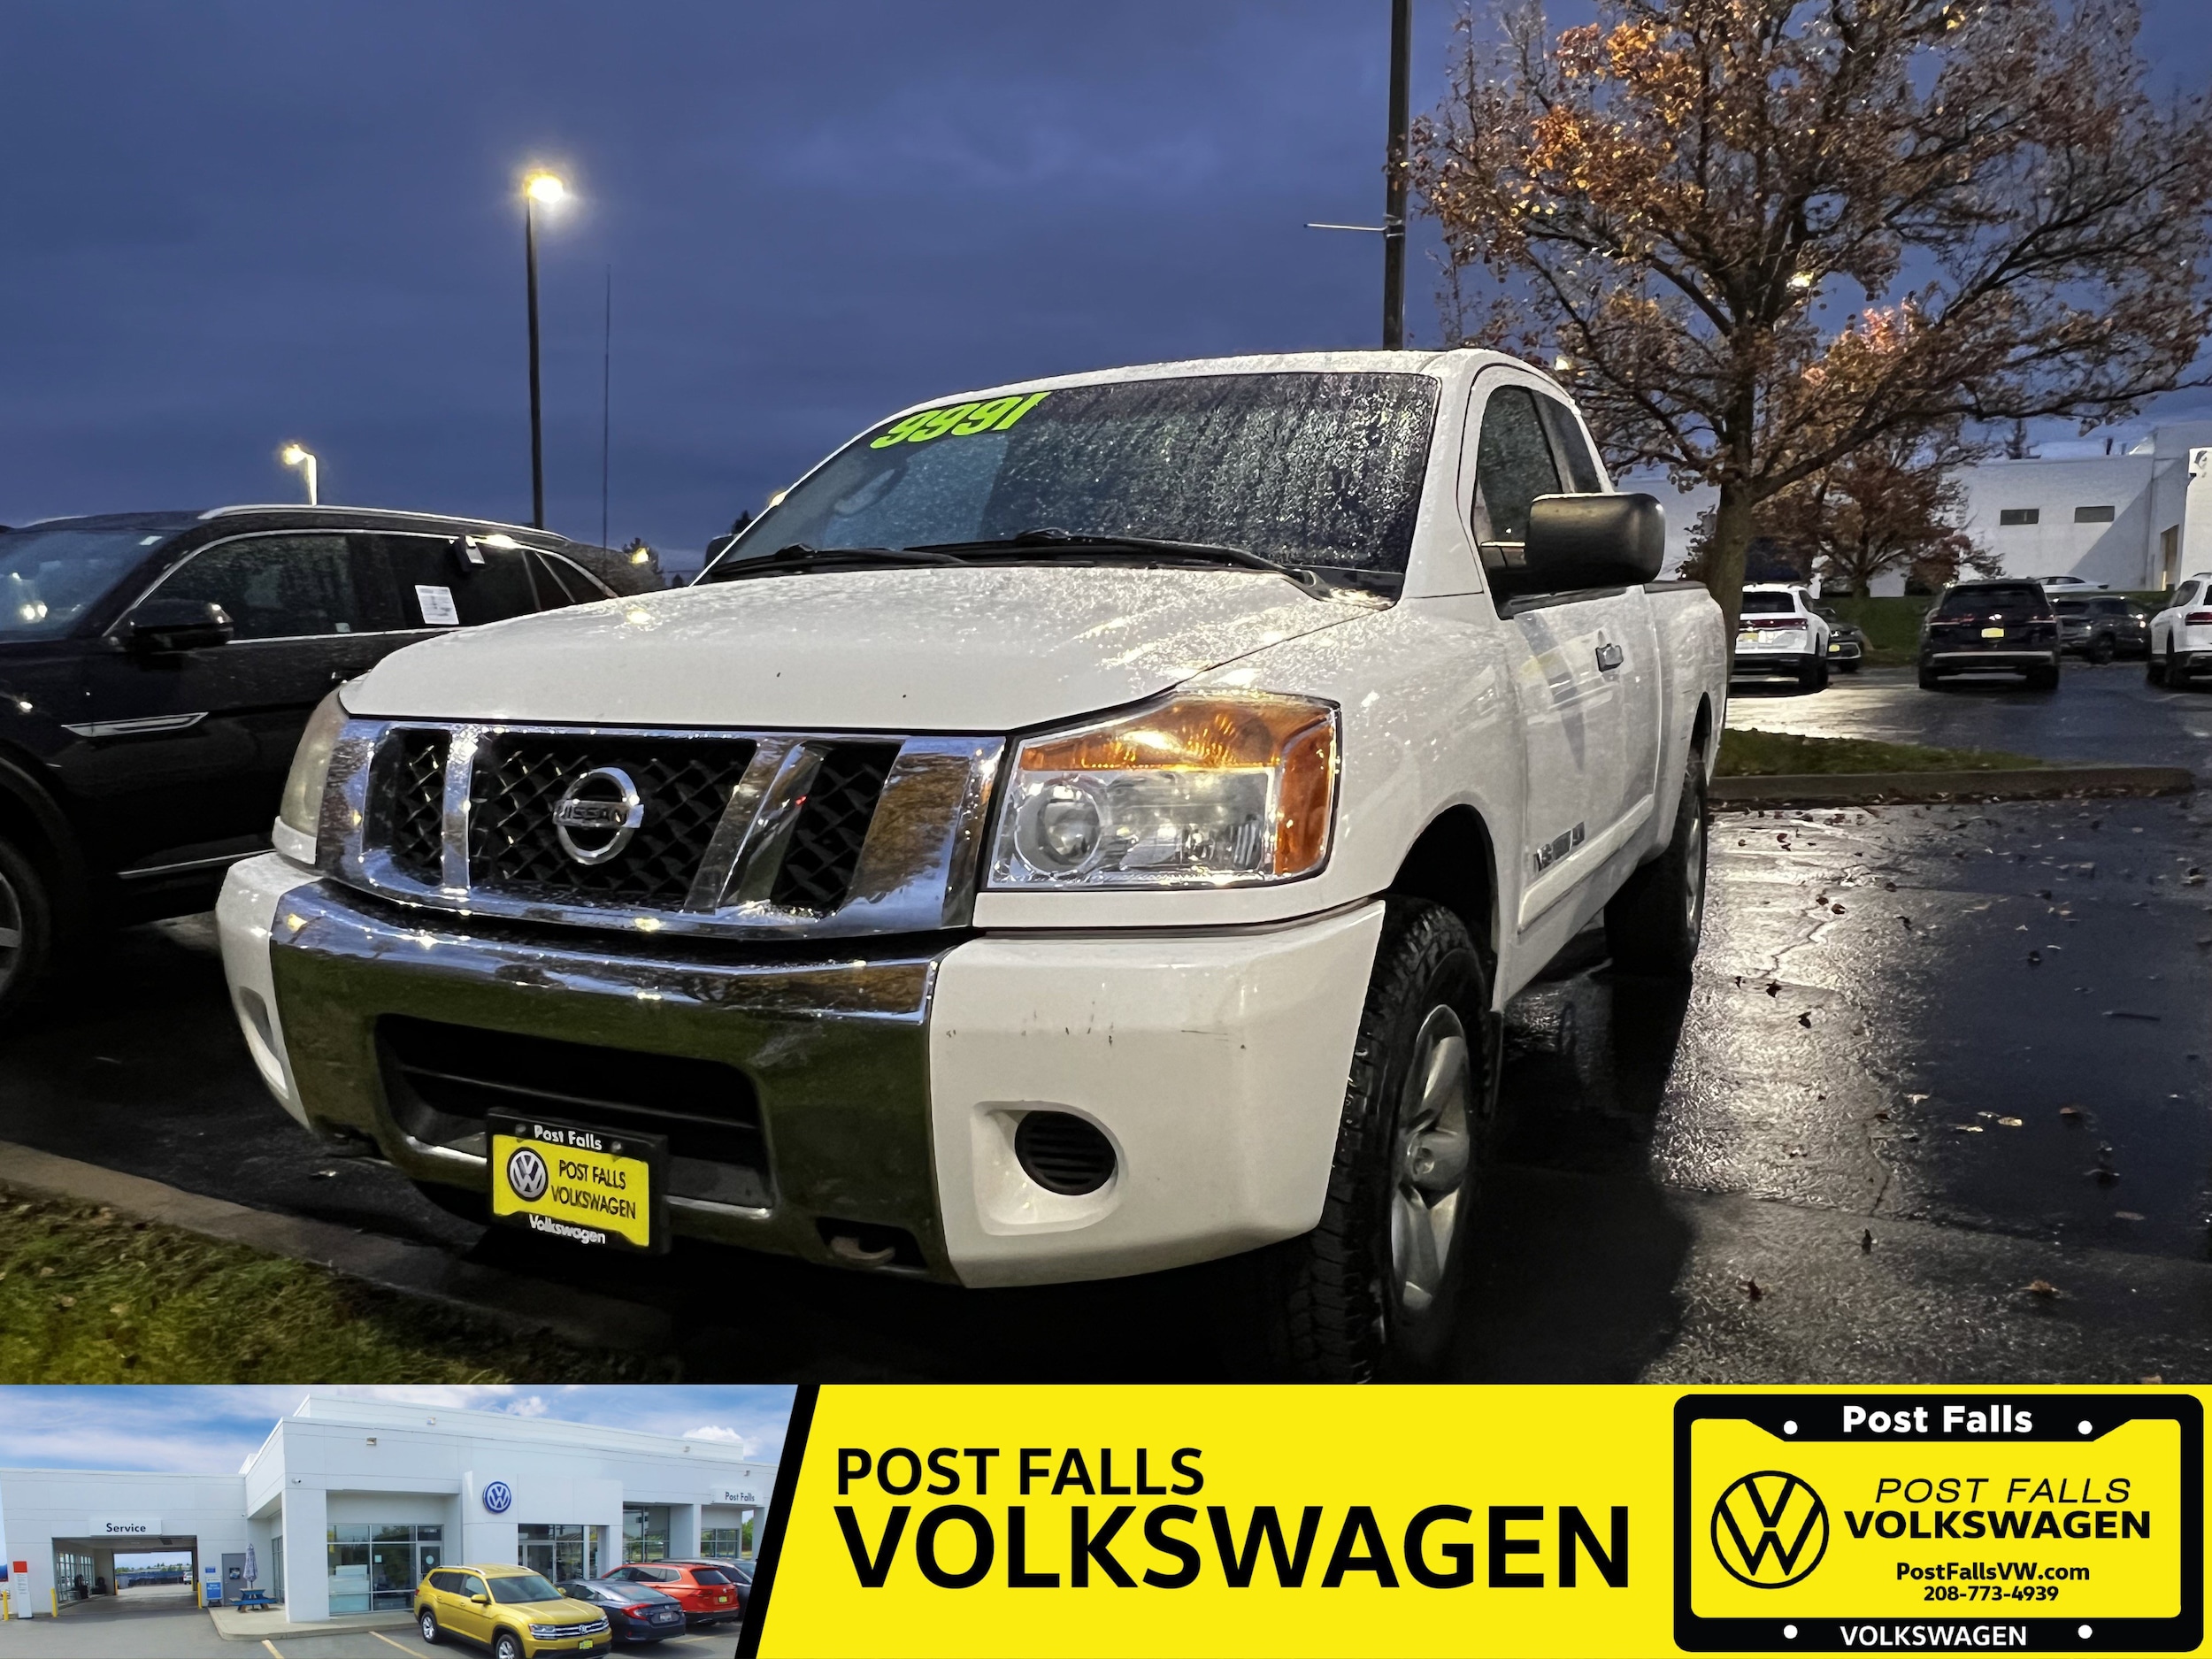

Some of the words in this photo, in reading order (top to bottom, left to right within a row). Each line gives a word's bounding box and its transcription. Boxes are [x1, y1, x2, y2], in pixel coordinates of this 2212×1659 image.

[870, 391, 1051, 449] 9991
[534, 1125, 564, 1143] Post
[568, 1130, 603, 1150] Falls
[559, 1159, 588, 1182] POST
[593, 1166, 626, 1190] FALLS
[551, 1185, 636, 1219] VOLKSWAGEN
[528, 1213, 606, 1244] Volkswagen
[726, 1491, 739, 1501] Post
[741, 1493, 755, 1502] Falls
[106, 1523, 146, 1532] Service
